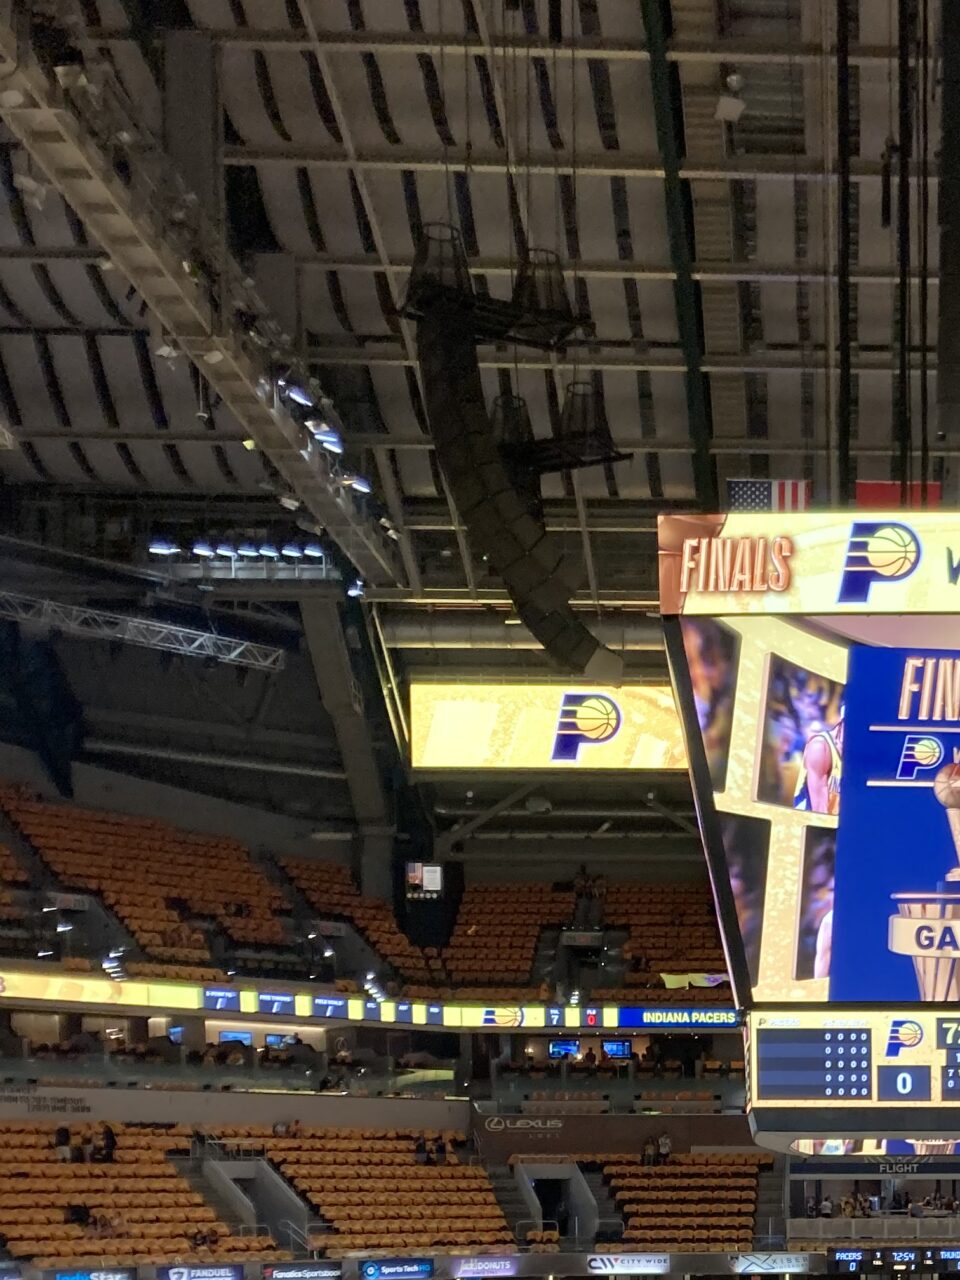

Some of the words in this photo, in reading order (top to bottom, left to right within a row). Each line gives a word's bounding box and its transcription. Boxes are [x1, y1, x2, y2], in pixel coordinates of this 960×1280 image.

[680, 536, 793, 594] FINALS
[552, 1015, 559, 1025] 7
[587, 1015, 596, 1025] 0
[643, 1012, 690, 1023] INDIANA
[691, 1012, 736, 1023] PACERS
[948, 1069, 955, 1077] 7
[896, 1072, 912, 1094] 0
[948, 1080, 954, 1088] 0
[506, 1119, 563, 1128] LEXUS
[879, 1163, 920, 1174] FLIGHT
[771, 1256, 808, 1265] XIBER
[836, 1252, 862, 1260] PACERS
[478, 1260, 511, 1270] DONUTS
[849, 1262, 857, 1271] 0
[190, 1268, 232, 1278] FANDUEL
